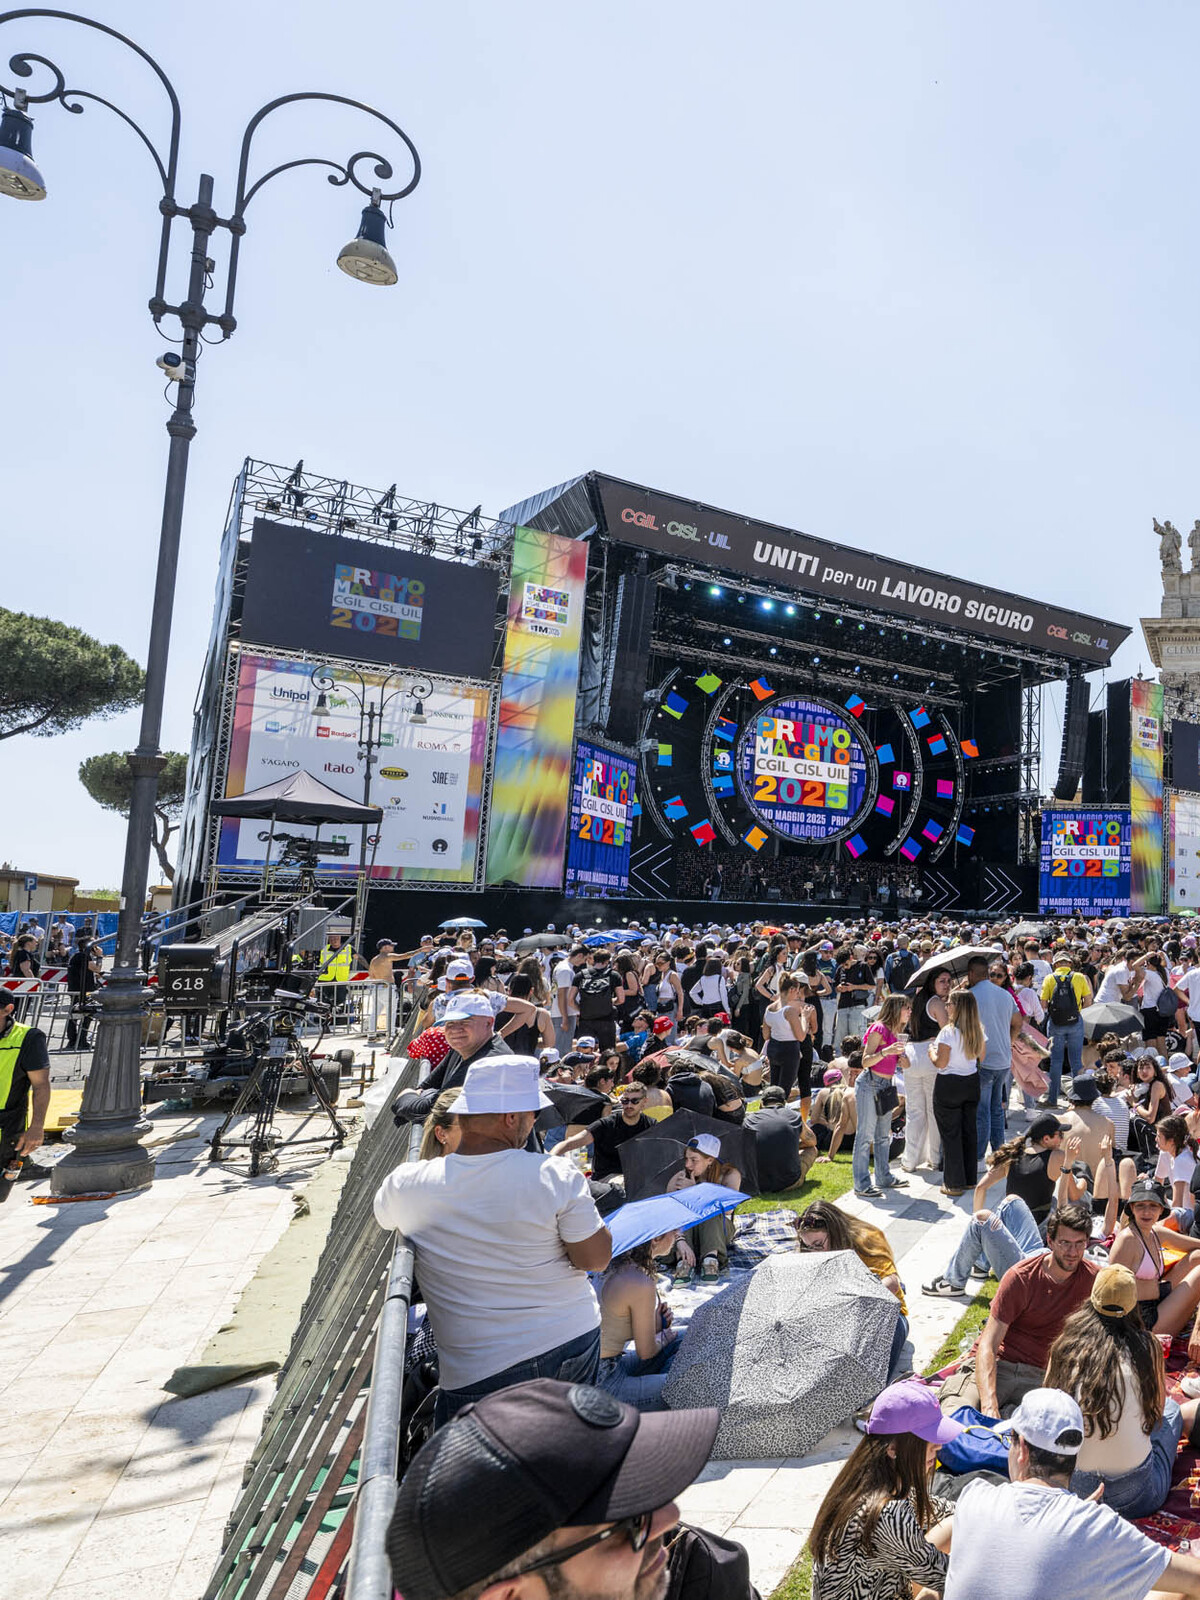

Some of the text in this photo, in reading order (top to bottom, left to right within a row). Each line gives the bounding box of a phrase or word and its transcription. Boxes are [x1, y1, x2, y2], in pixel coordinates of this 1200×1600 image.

[621, 508, 731, 550] CGIL CISL UIL
[335, 564, 425, 595] PRIMO
[753, 541, 1034, 632] UNITI per un LAVORO SICURO
[334, 595, 422, 619] CGIL CISL UIL
[525, 607, 568, 624] 2025
[330, 607, 422, 640] 2025
[1047, 624, 1109, 650] CGIL CISL UIL
[273, 686, 310, 703] Unipol
[756, 717, 851, 749] PRIMO
[417, 740, 448, 752] ROMA
[755, 736, 851, 765] MAGGIO
[323, 762, 355, 774] italo
[583, 758, 629, 790] PRIMO
[756, 758, 848, 780] CGIL CISL UIL
[432, 771, 448, 785] SIAE
[582, 777, 628, 805] MAGGIO
[754, 775, 848, 810] 2025
[582, 797, 598, 812] CGIL
[600, 802, 614, 816] CISL
[616, 807, 626, 818] UIL
[775, 810, 804, 823] MAGGIO
[806, 812, 826, 824] 2025
[578, 813, 626, 847] 2025
[792, 823, 826, 838] MAGGIO
[1052, 821, 1121, 836] PRIMO
[1052, 834, 1121, 846] MAGGIO
[1053, 848, 1119, 857] CGIL CISL UIL
[1052, 859, 1120, 877] 2025
[27, 878, 36, 890] P
[1049, 897, 1072, 906] MAGGIO
[1073, 898, 1090, 906] 2025
[1093, 898, 1113, 906] PRIMO
[171, 977, 204, 991] 618
